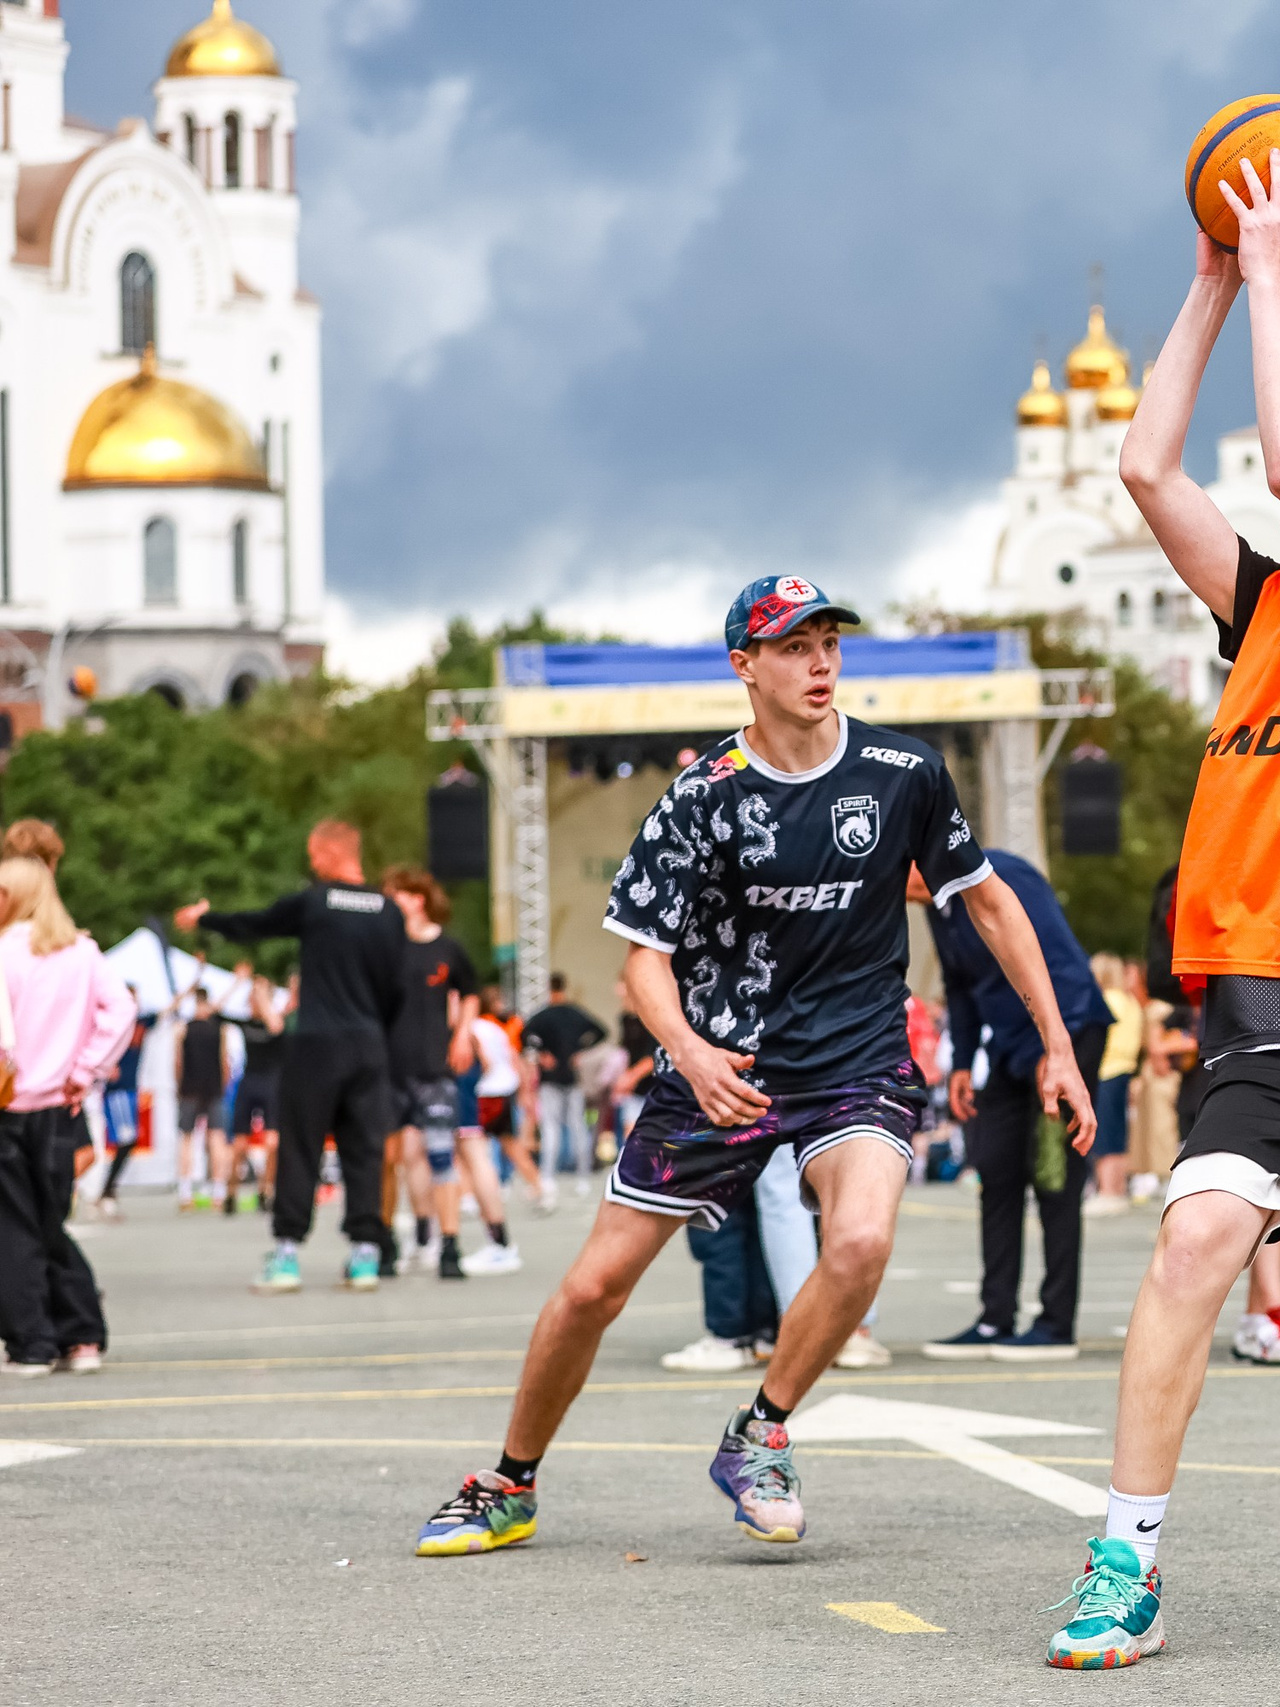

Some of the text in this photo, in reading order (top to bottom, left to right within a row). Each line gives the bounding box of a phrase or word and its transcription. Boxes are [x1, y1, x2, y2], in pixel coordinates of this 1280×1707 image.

[860, 746, 924, 770] 1XBET
[843, 799, 868, 808] SPIRIT
[745, 879, 864, 912] 1XBET
